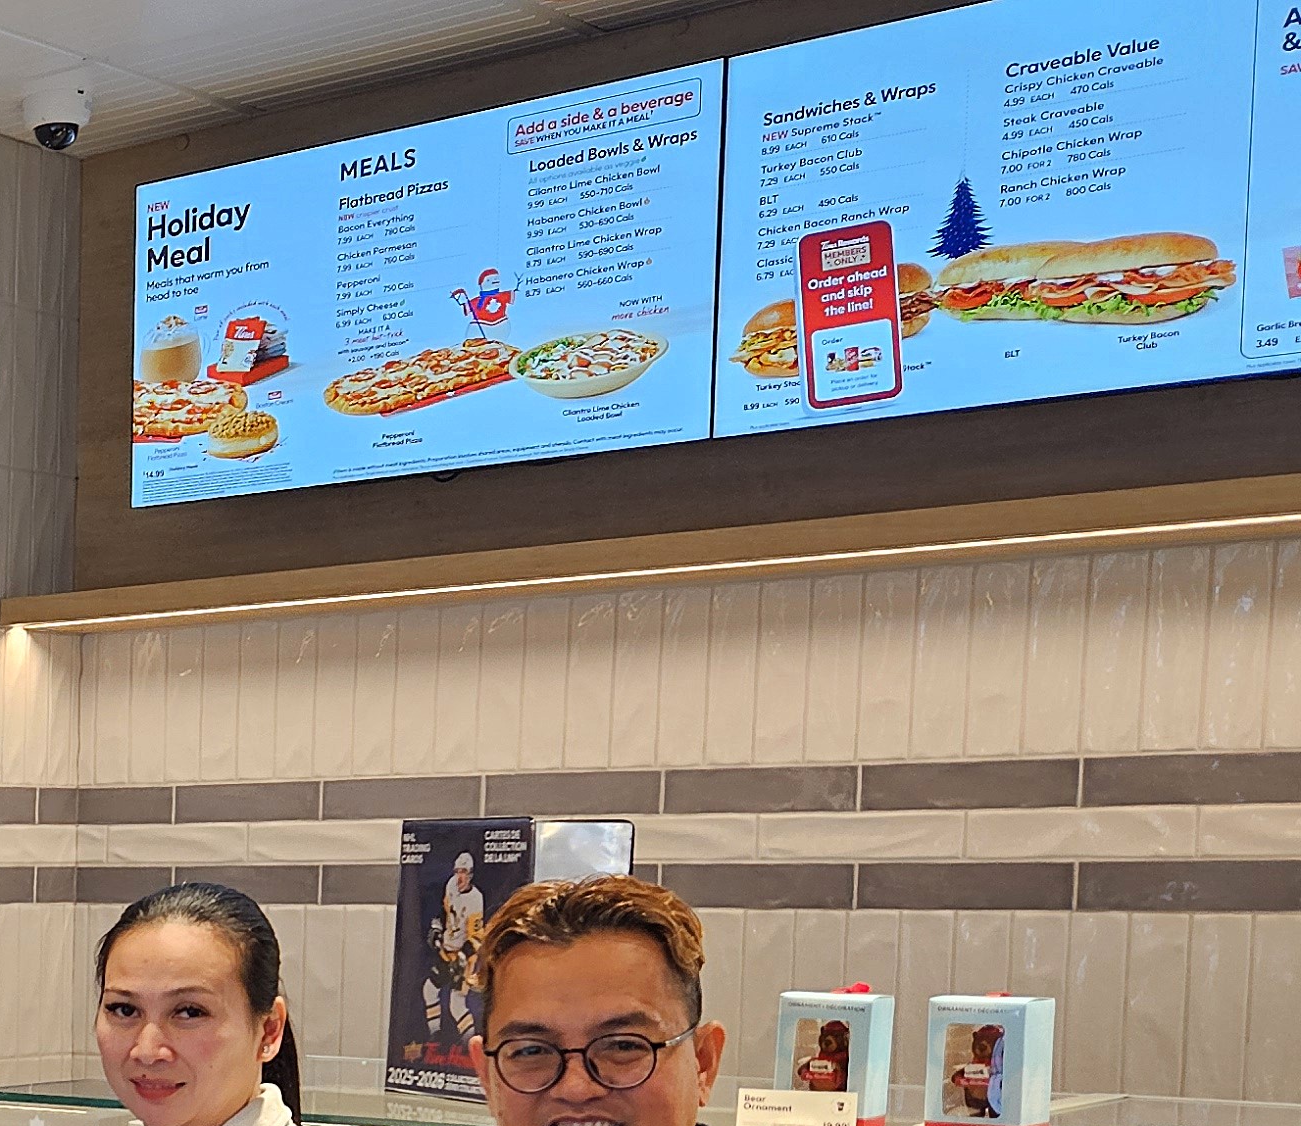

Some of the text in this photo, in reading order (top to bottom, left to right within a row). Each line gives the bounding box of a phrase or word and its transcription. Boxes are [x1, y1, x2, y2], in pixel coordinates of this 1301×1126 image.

[1005, 39, 1160, 78] Craveable Value
[1004, 57, 1164, 95] Crispy Chicken Craveable
[1070, 80, 1114, 95] 470 Cals
[515, 90, 694, 137] Add a side & a beverage
[763, 82, 937, 126] Sandwiches & Wraps
[1003, 101, 1105, 128] Steak Craveable
[529, 150, 584, 173] Loaded
[587, 142, 630, 162] Bowls
[633, 138, 645, 152] &
[648, 129, 698, 149] Wraps
[1001, 129, 1143, 161] Chipotle Chicken Wrap
[340, 148, 416, 182] MEALS
[760, 149, 863, 175] Turkey Bacon Club
[839, 161, 860, 172] Cals
[1000, 166, 1127, 194] Ranch Chicken Wrap
[147, 200, 170, 213] NEW
[339, 180, 449, 210] Flatbread Pizzas
[759, 194, 779, 206] BLT
[147, 202, 252, 242] Holiday
[527, 198, 643, 227] Habanero Chicken Bowl
[758, 204, 910, 238] Chicken Bacon Ranch Wrap
[147, 236, 211, 273] Meal
[824, 245, 867, 260] MEMBERS
[807, 266, 888, 290] Order ahead
[821, 285, 872, 303] and skip
[824, 299, 873, 317] the line!
[1255, 337, 1279, 349] 3.49
[743, 1101, 793, 1113] Ornament
[744, 1093, 767, 1103] Bear
